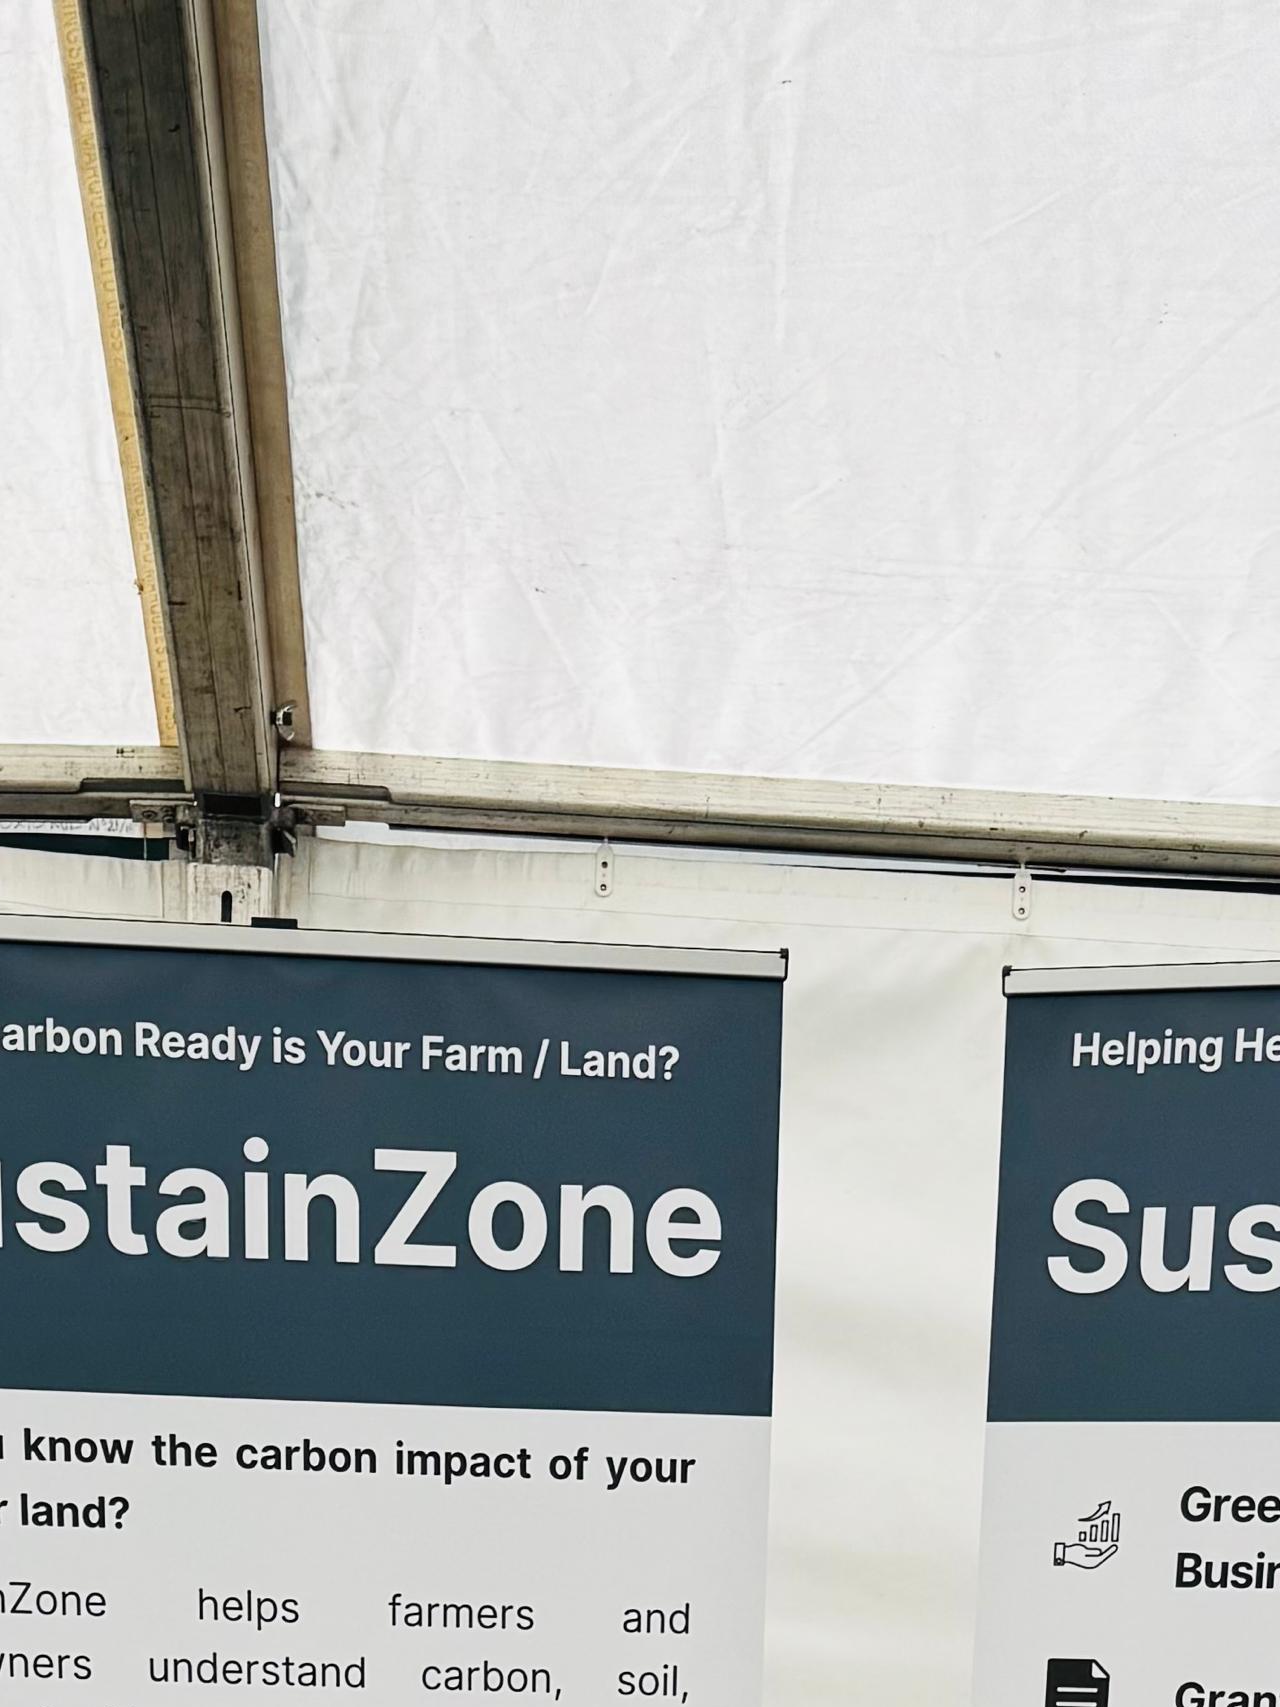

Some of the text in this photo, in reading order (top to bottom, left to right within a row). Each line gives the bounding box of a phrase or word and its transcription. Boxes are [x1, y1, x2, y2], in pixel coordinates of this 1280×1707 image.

[134, 1022, 260, 1071] Ready
[271, 1028, 305, 1064] is
[317, 1029, 410, 1070] Your
[421, 1035, 521, 1074] Farm
[560, 1040, 680, 1080] Land?
[1071, 1032, 1224, 1071] Helping
